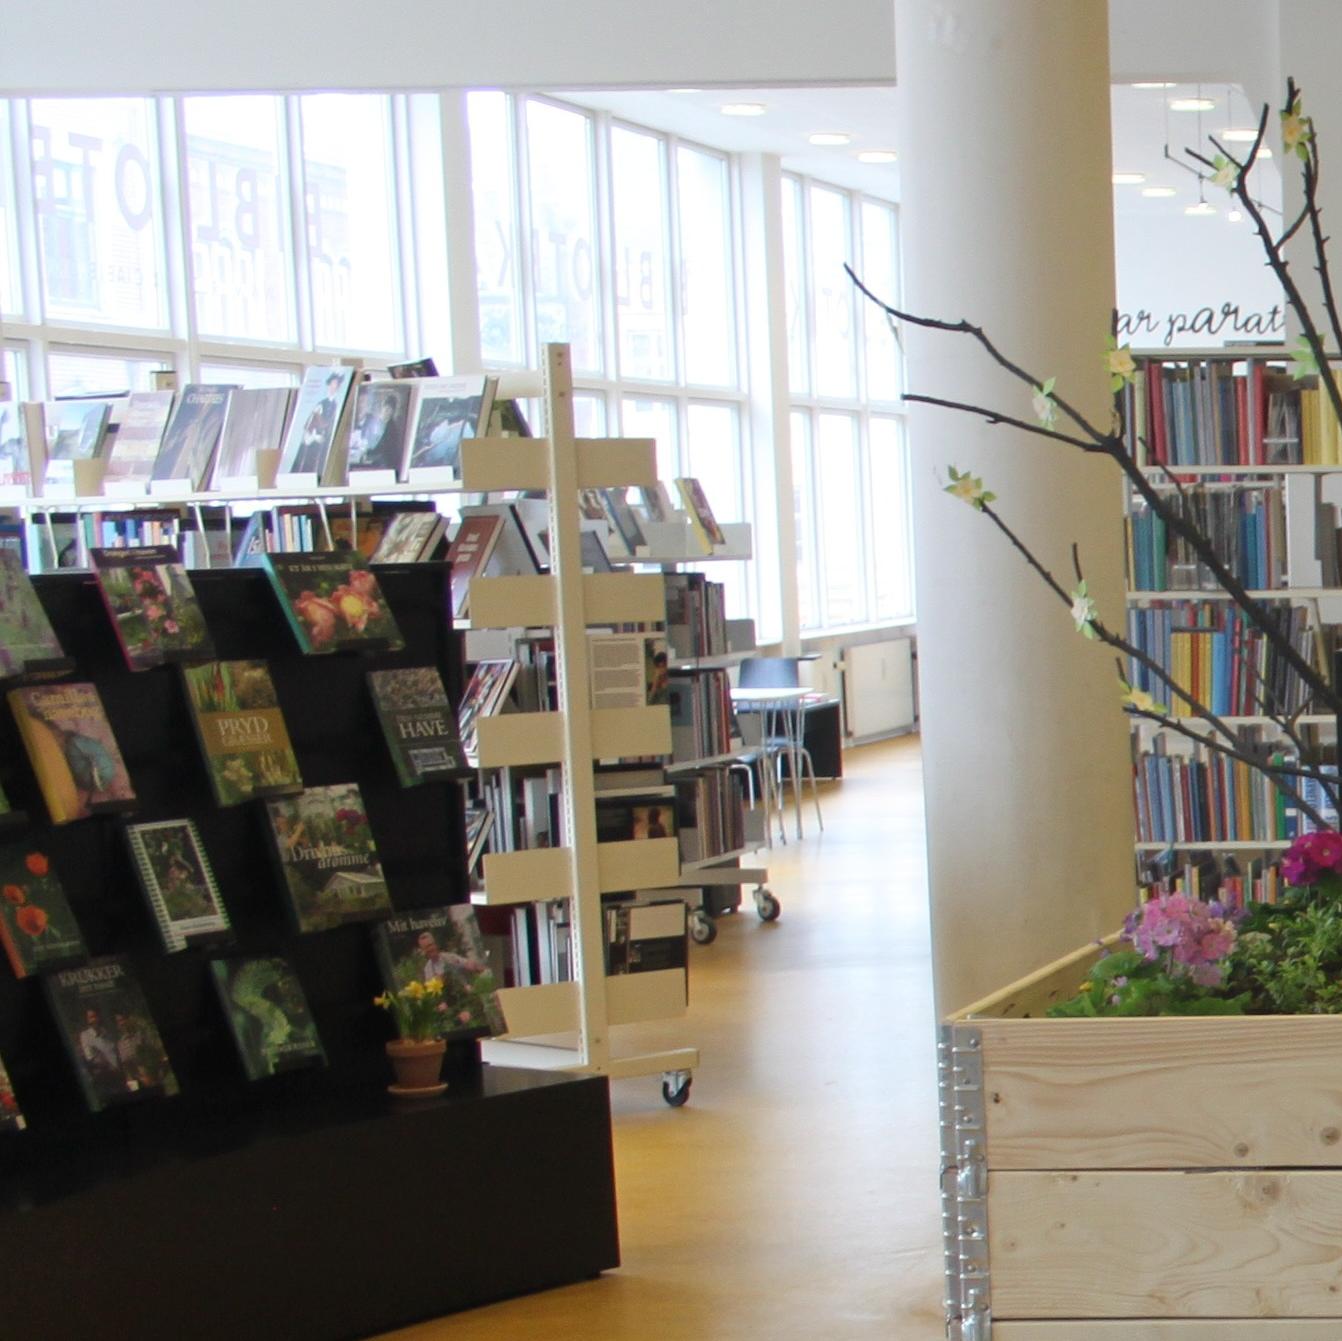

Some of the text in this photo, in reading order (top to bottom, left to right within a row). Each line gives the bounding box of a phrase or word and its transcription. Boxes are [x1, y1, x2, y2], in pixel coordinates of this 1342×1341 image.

[1117, 301, 1286, 346] ar parat
[215, 716, 269, 736] PRYD
[399, 720, 449, 739] HAVE
